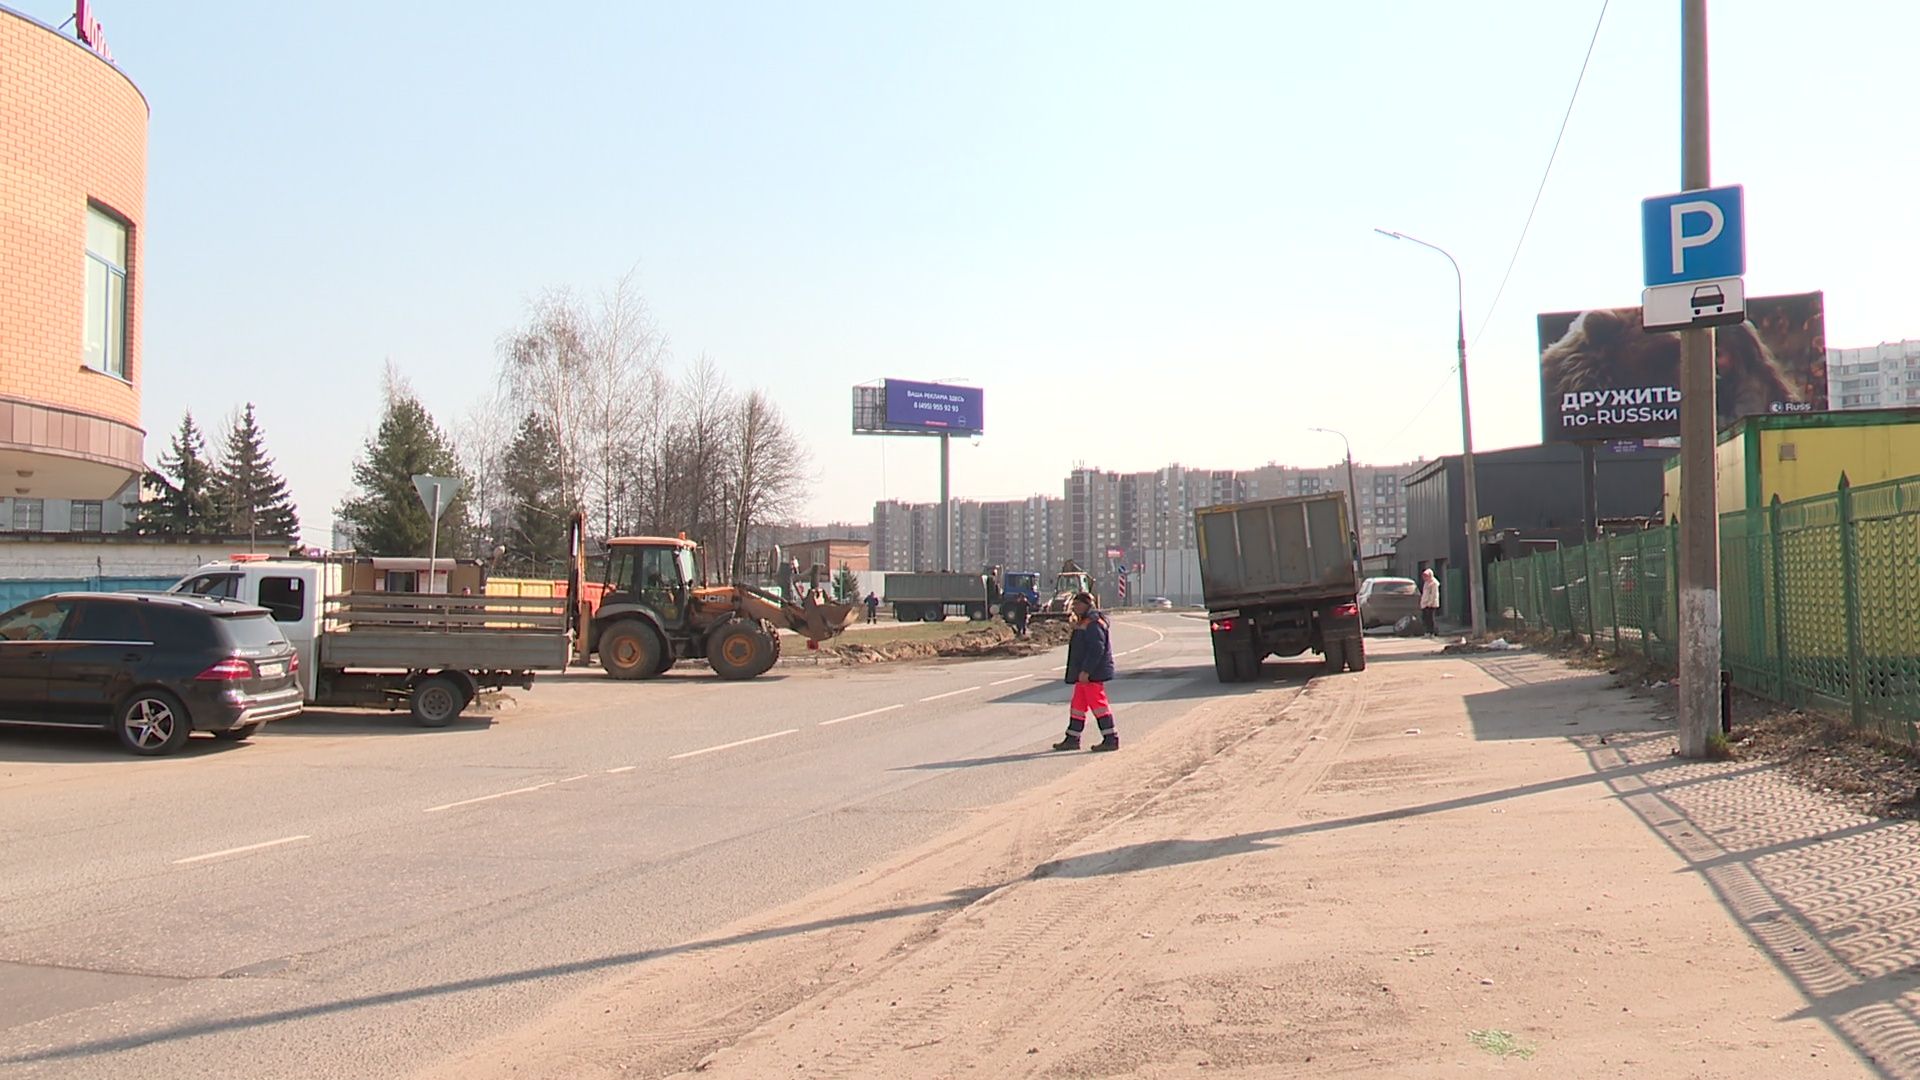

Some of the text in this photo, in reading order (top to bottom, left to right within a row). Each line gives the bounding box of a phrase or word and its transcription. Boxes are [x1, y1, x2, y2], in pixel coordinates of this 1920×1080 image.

[1670, 201, 1725, 274] P
[924, 392, 948, 400] РЕКЛАМА
[1561, 387, 1682, 412] ДРУЖИТЬ
[1785, 402, 1811, 411] Russ
[1562, 407, 1678, 427] по-RUSSки
